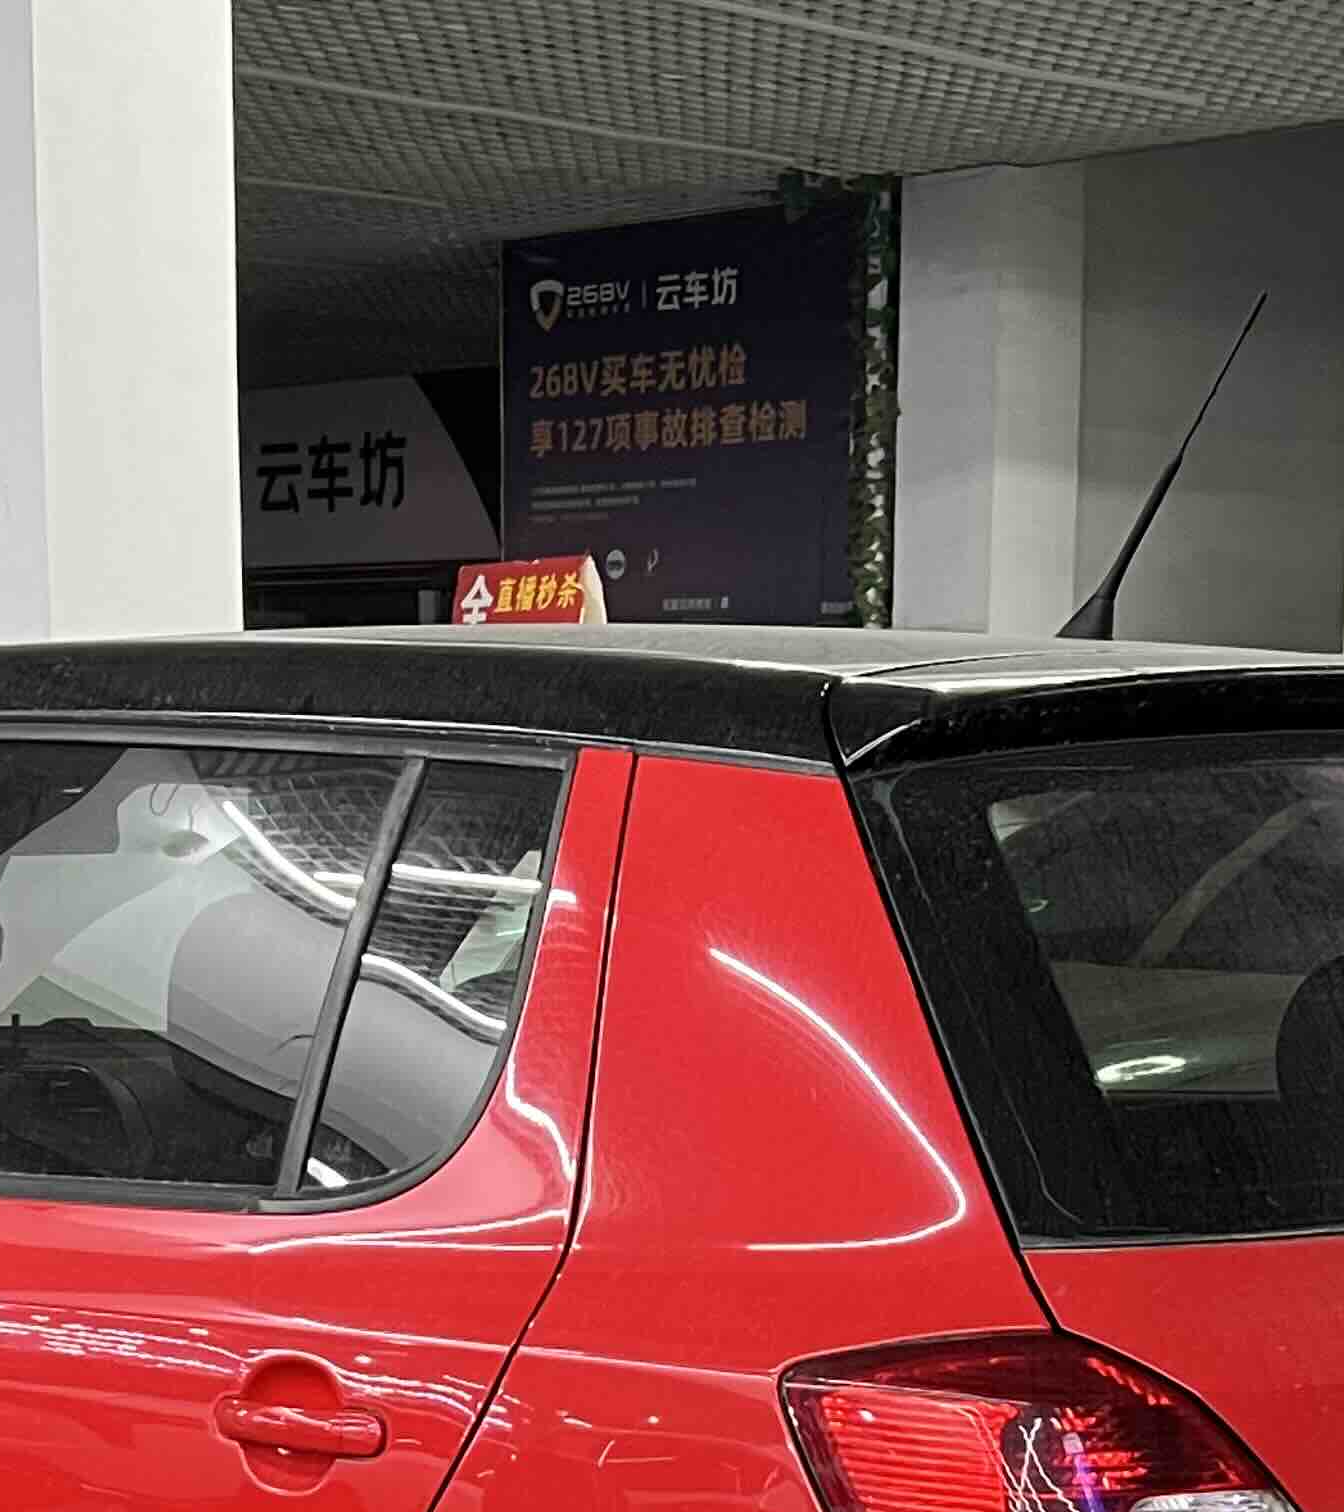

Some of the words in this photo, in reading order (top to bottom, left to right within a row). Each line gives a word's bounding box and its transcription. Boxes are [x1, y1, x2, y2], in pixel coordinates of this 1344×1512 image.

[656, 267, 739, 311] 云车坊
[528, 343, 747, 399] 268V买车无忧检
[530, 399, 807, 458] 享127项事故排查检测
[257, 429, 407, 513] 云车坊
[493, 572, 584, 613] 直播秒杀
